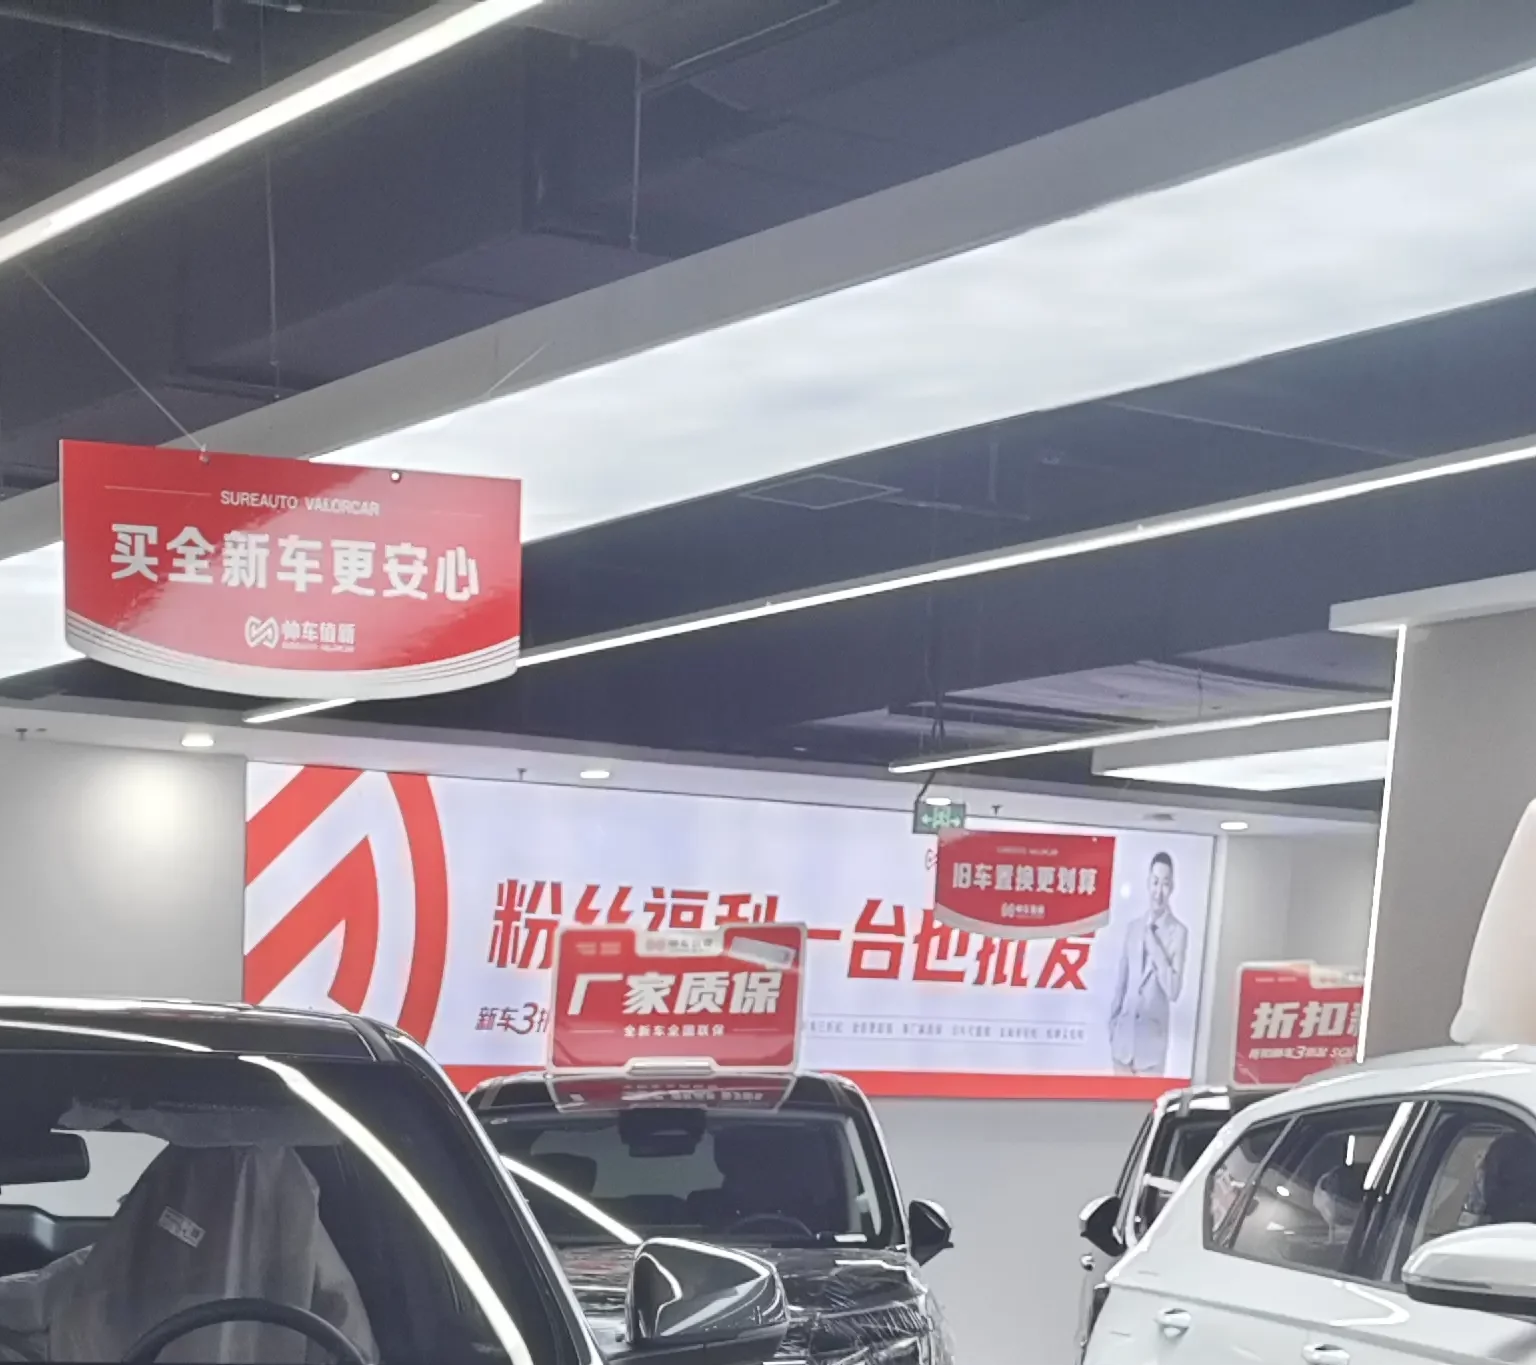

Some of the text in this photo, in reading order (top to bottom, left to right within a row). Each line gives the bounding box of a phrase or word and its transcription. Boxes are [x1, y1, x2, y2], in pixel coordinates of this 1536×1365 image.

[220, 490, 381, 517] SUREAUTO VALORCAR
[109, 523, 481, 603] 买全新车更安心
[952, 862, 1098, 895] 旧车置换更划算
[567, 971, 783, 1016] 厂家质保
